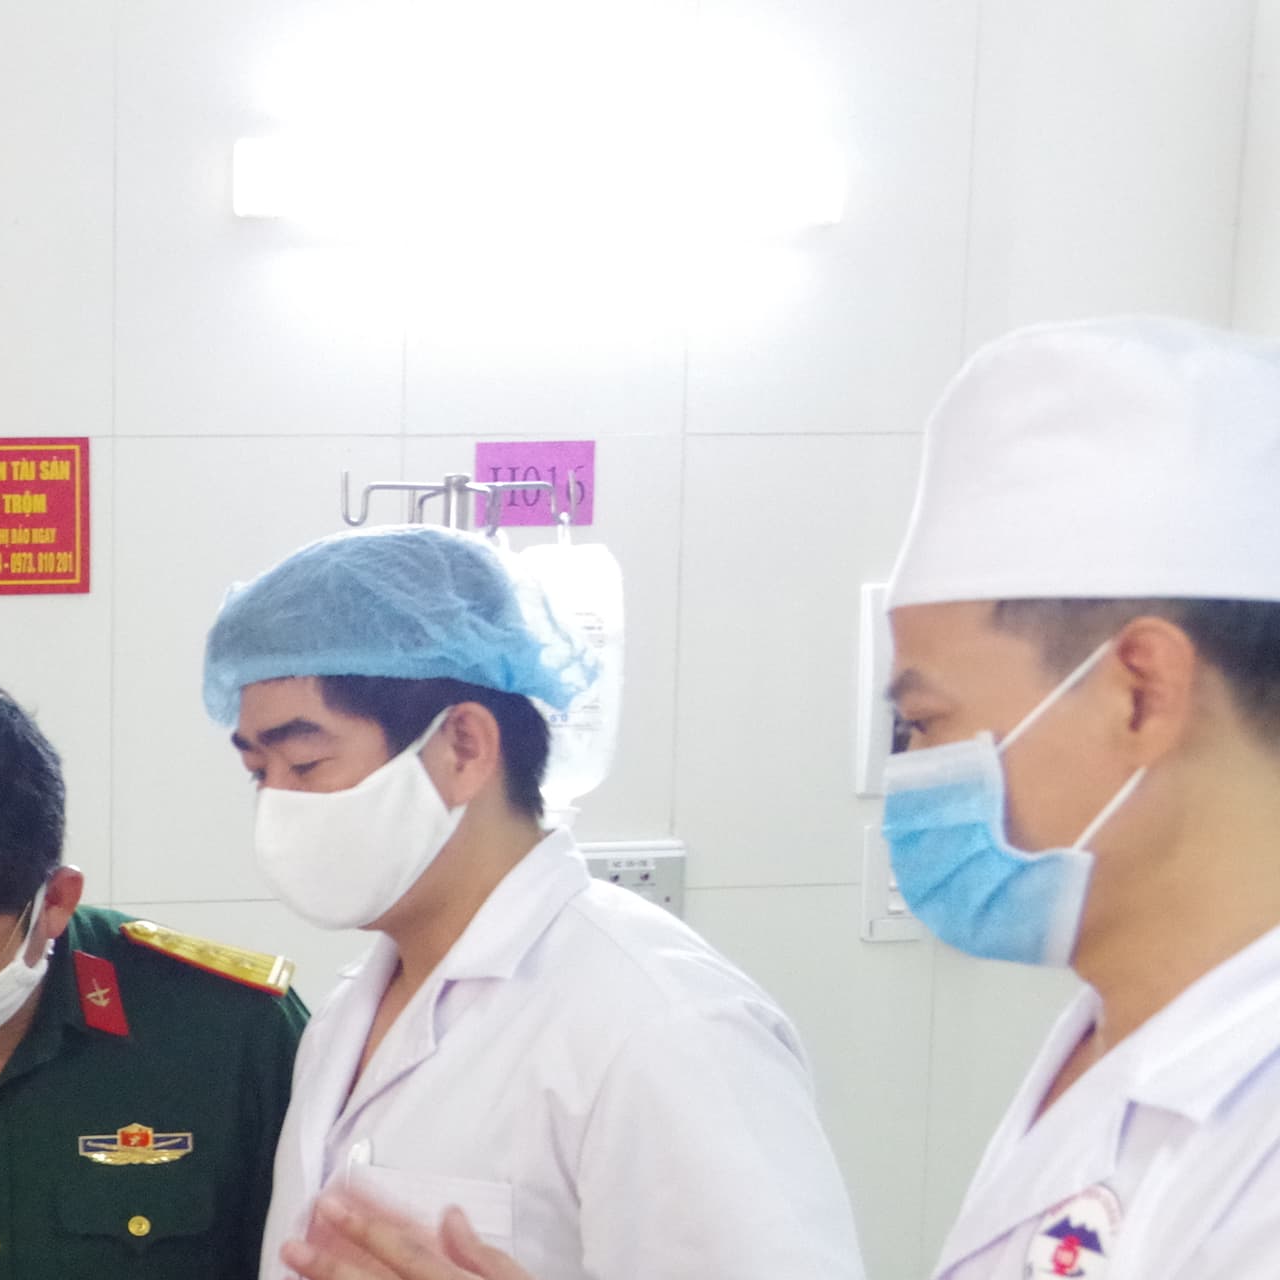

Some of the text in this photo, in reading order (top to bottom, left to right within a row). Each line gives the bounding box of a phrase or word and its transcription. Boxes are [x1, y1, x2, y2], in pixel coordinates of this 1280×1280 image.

[11, 457, 36, 481] TÀI
[39, 455, 71, 481] SẢN
[2, 490, 48, 518] TRỘM
